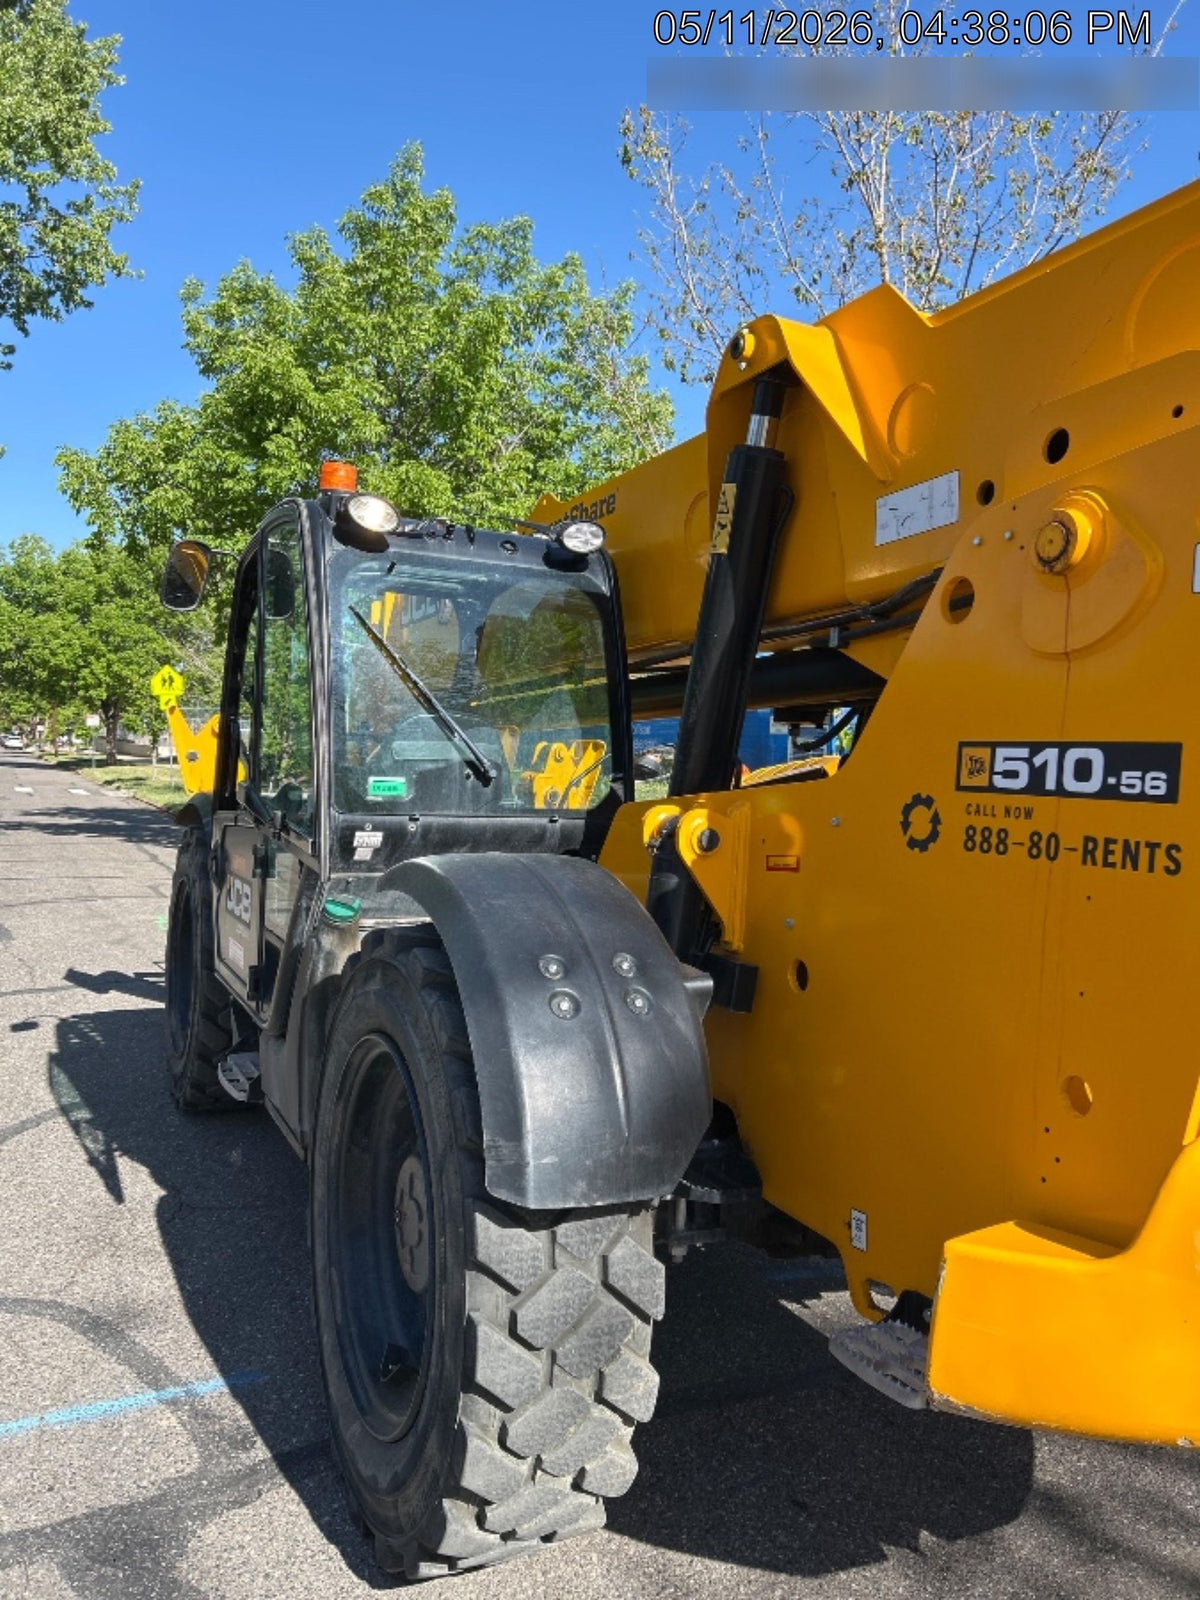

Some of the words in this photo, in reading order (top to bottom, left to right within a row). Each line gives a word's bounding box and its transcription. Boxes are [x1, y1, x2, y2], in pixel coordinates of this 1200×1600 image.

[965, 803, 997, 819] CALL
[1004, 805, 1035, 821] NOW
[963, 824, 1182, 876] 888-80-RENTS
[226, 875, 252, 924] JCB
